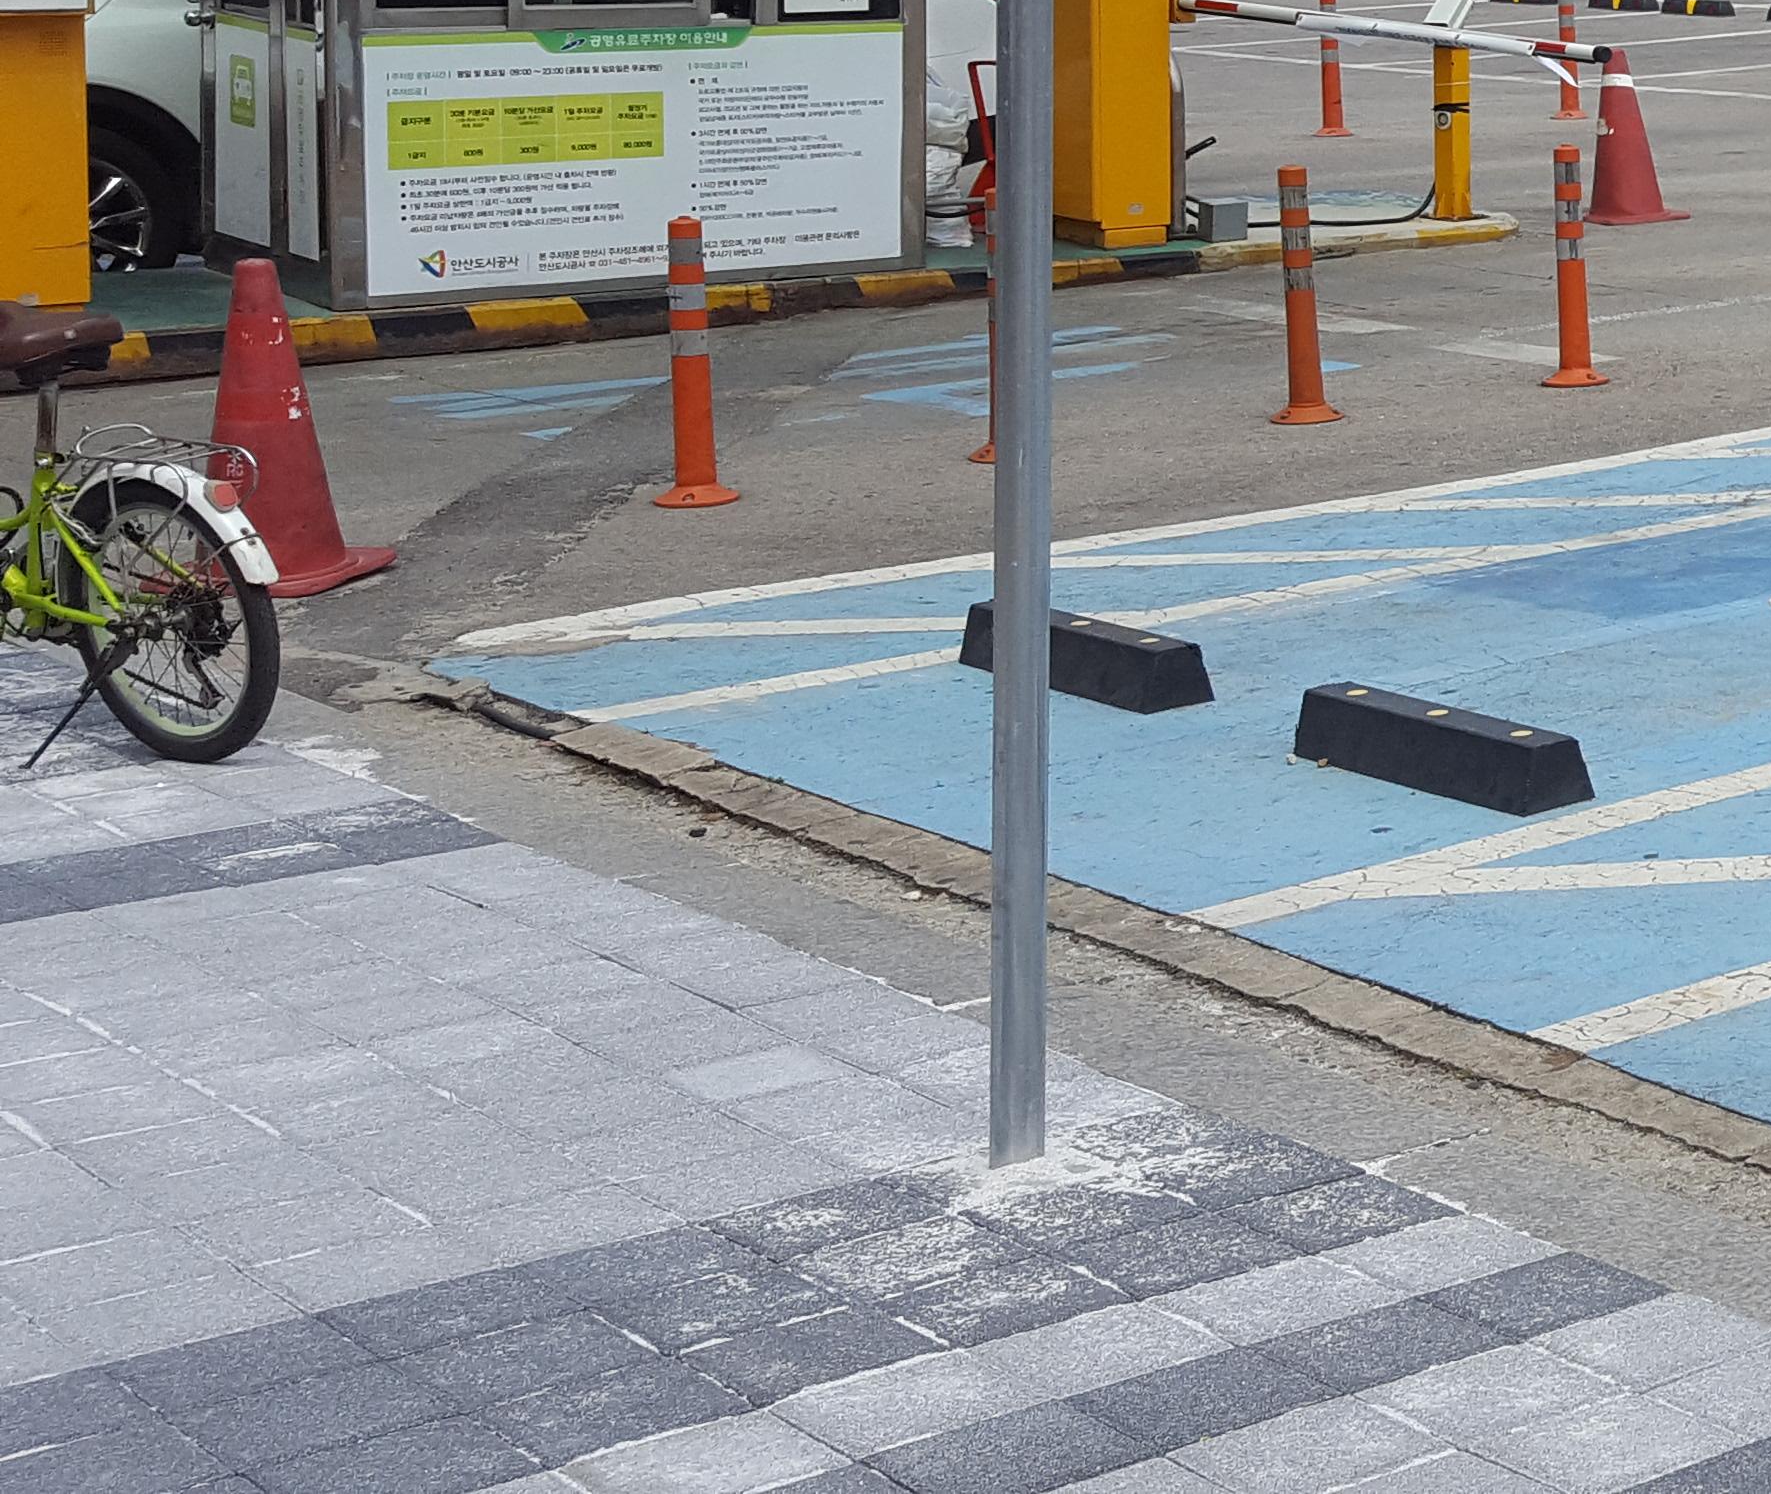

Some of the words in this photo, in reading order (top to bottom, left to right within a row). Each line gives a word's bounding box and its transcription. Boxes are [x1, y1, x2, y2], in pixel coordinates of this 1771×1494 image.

[589, 32, 678, 48] 공영유료주차장
[680, 30, 728, 45] 이용안내
[451, 257, 519, 272] 안산도시공사
